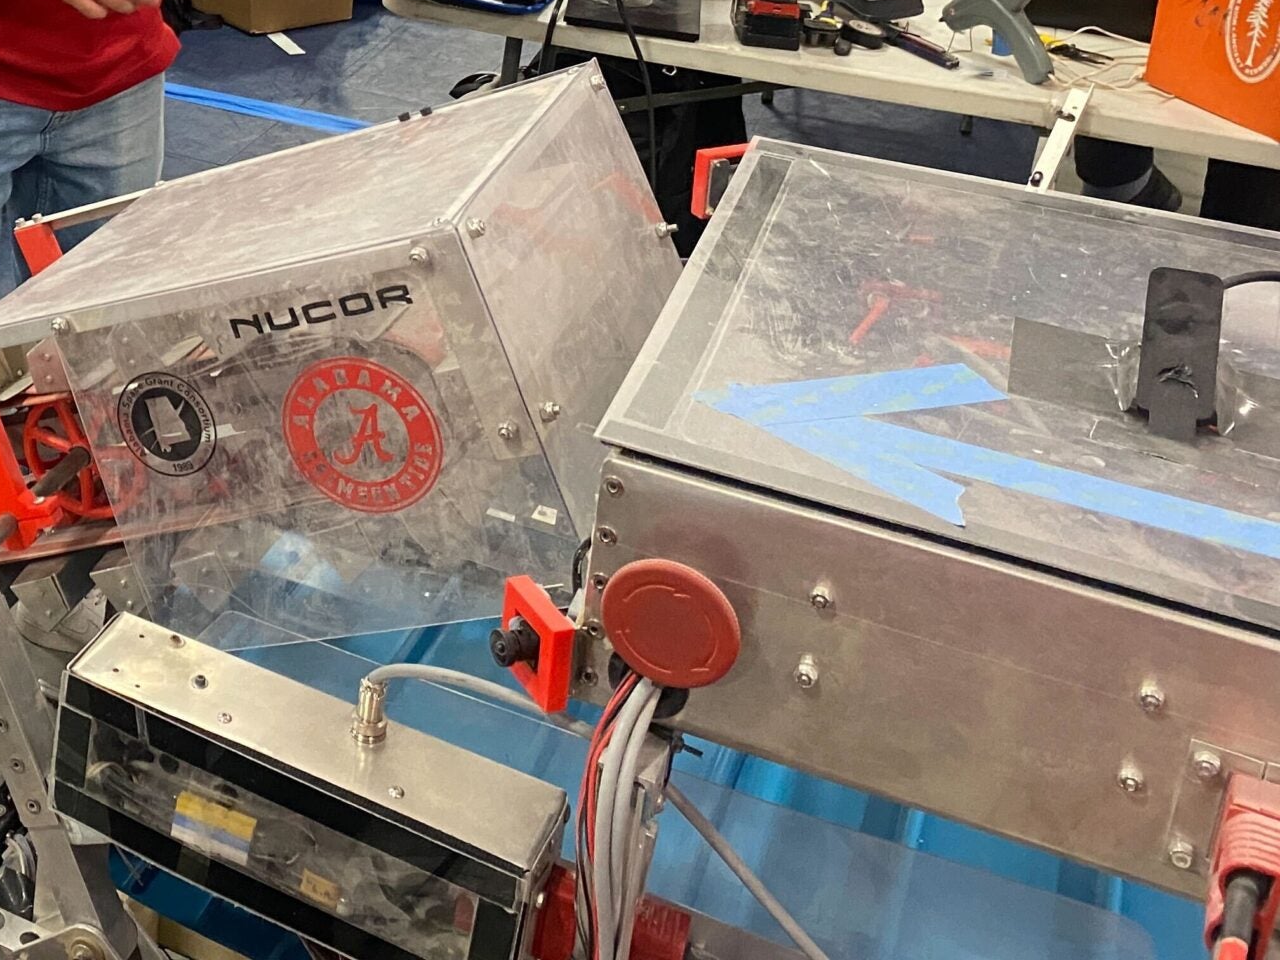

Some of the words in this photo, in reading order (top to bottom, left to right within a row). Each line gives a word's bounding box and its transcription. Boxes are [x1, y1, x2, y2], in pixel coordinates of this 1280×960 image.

[229, 285, 413, 339] NUCOR
[122, 412, 147, 457] Alabama
[144, 377, 174, 387] Grant
[176, 383, 212, 443] Consortium
[292, 368, 421, 429] ALABAMA
[333, 403, 395, 465] A
[172, 461, 195, 473] 1989
